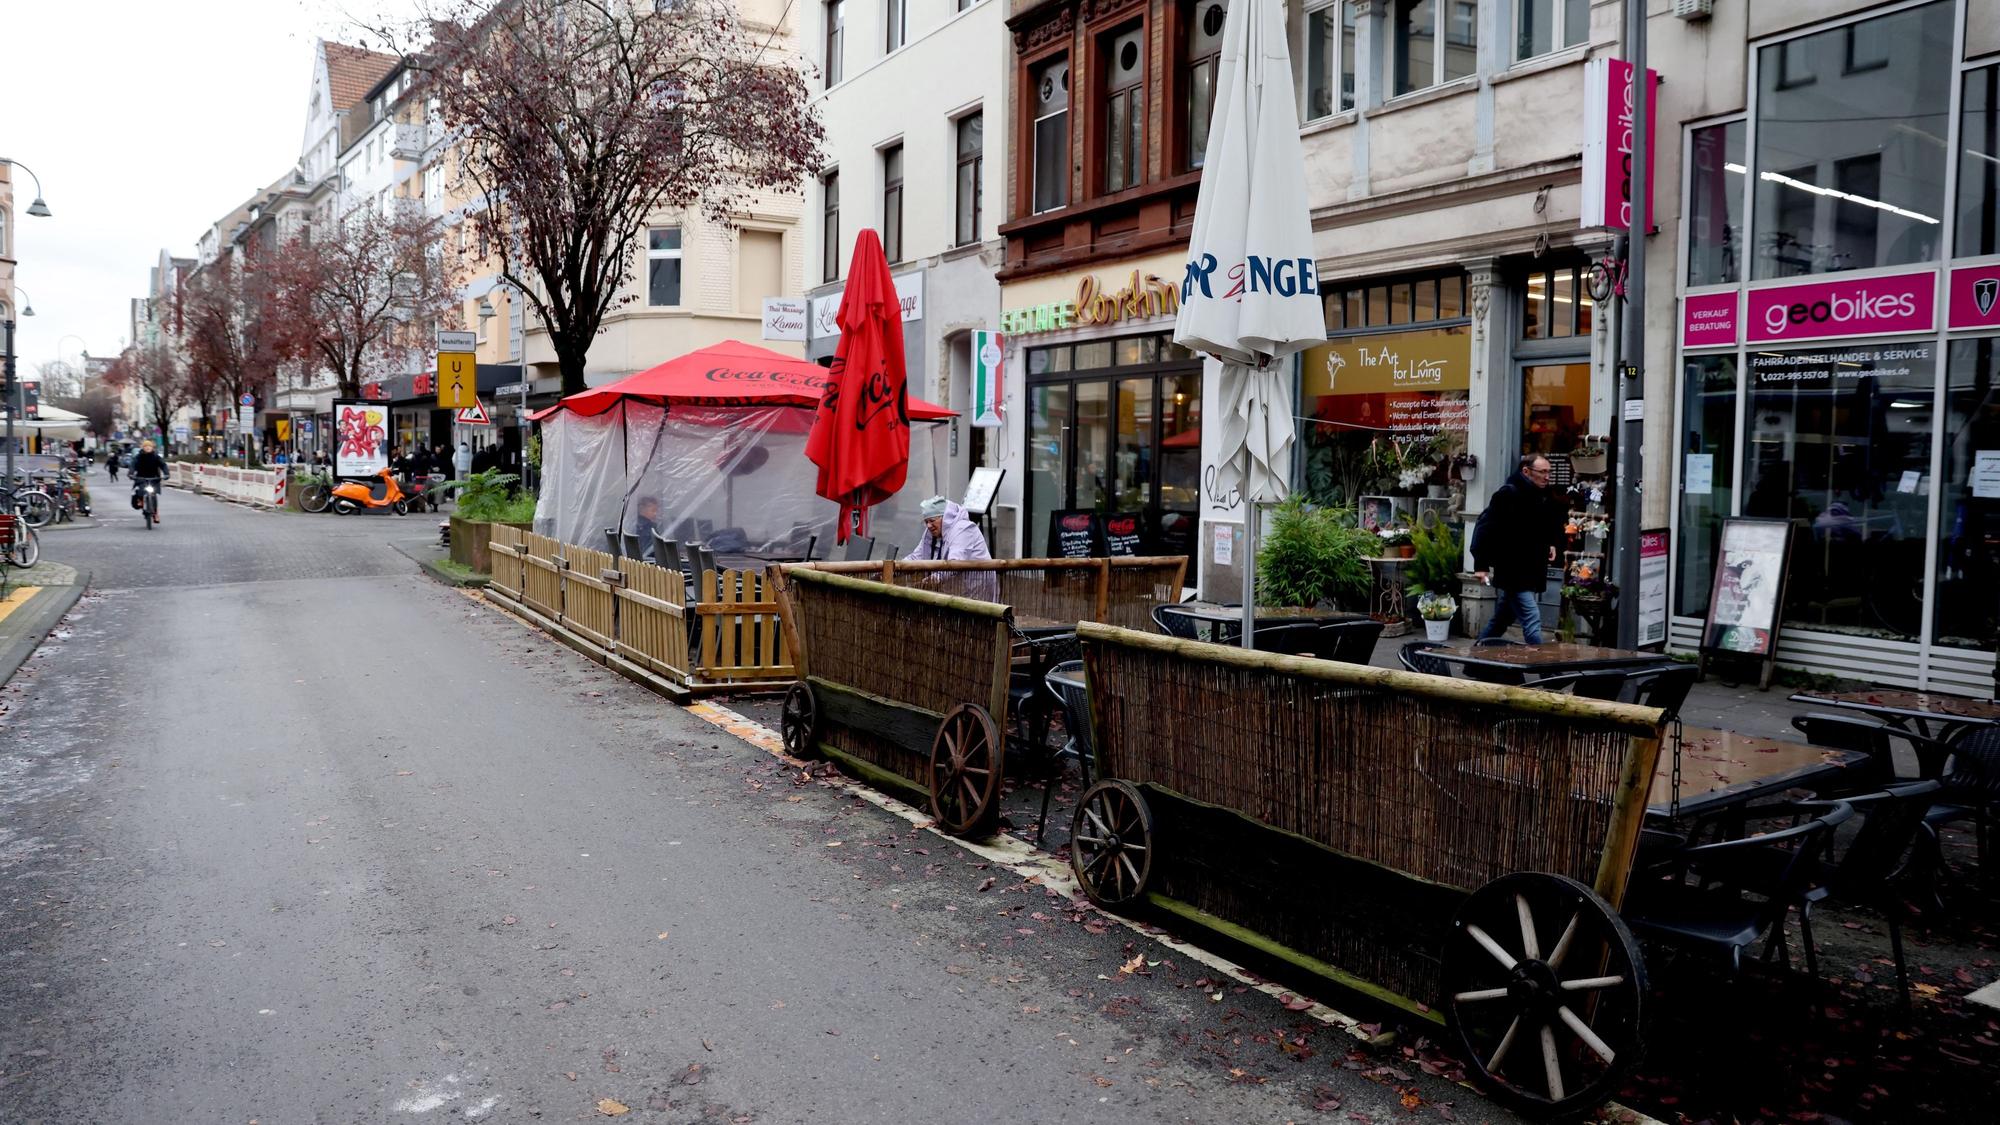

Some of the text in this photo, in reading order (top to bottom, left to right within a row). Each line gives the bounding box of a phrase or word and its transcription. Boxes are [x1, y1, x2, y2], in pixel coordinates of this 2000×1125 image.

[1692, 308, 1729, 320] VERKAUF
[1765, 290, 1916, 335] geobikes
[766, 315, 803, 333] Lanna
[1689, 321, 1731, 332] BERATUNG
[1358, 346, 1399, 368] The Art
[1753, 349, 1929, 368] FAHRRADEINZELHANDEL & SERVICE
[452, 360, 462, 373] U
[1393, 360, 1441, 381] for Living
[1627, 367, 1637, 376] 12
[1837, 368, 1910, 378] www.geobikes.de
[1392, 401, 1420, 410] Konzepte
[1420, 399, 1430, 408] für
[1392, 412, 1410, 420] Wohn-
[1411, 411, 1422, 419] und
